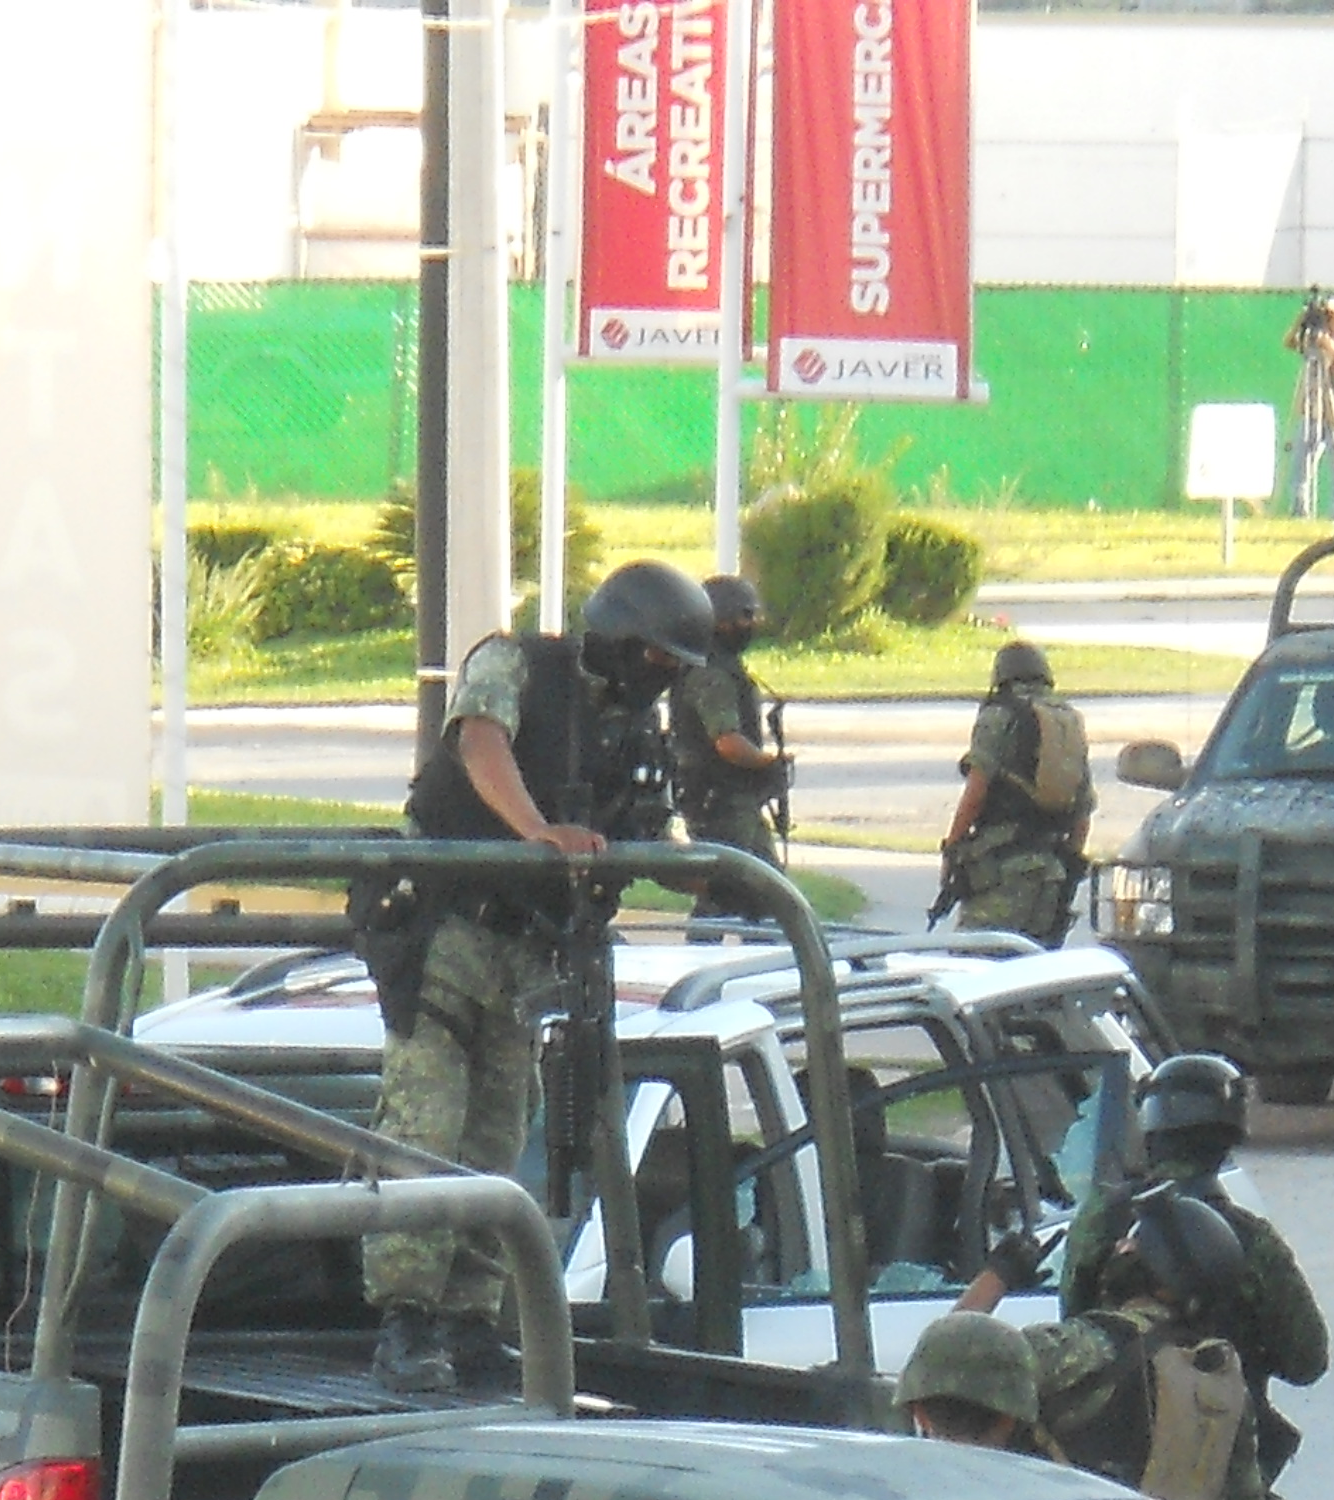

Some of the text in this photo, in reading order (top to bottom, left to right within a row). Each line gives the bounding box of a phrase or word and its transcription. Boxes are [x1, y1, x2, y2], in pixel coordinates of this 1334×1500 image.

[604, 1, 660, 196] ÁREAS
[850, 0, 894, 317] SUPERMERC
[832, 358, 943, 380] JAVER
